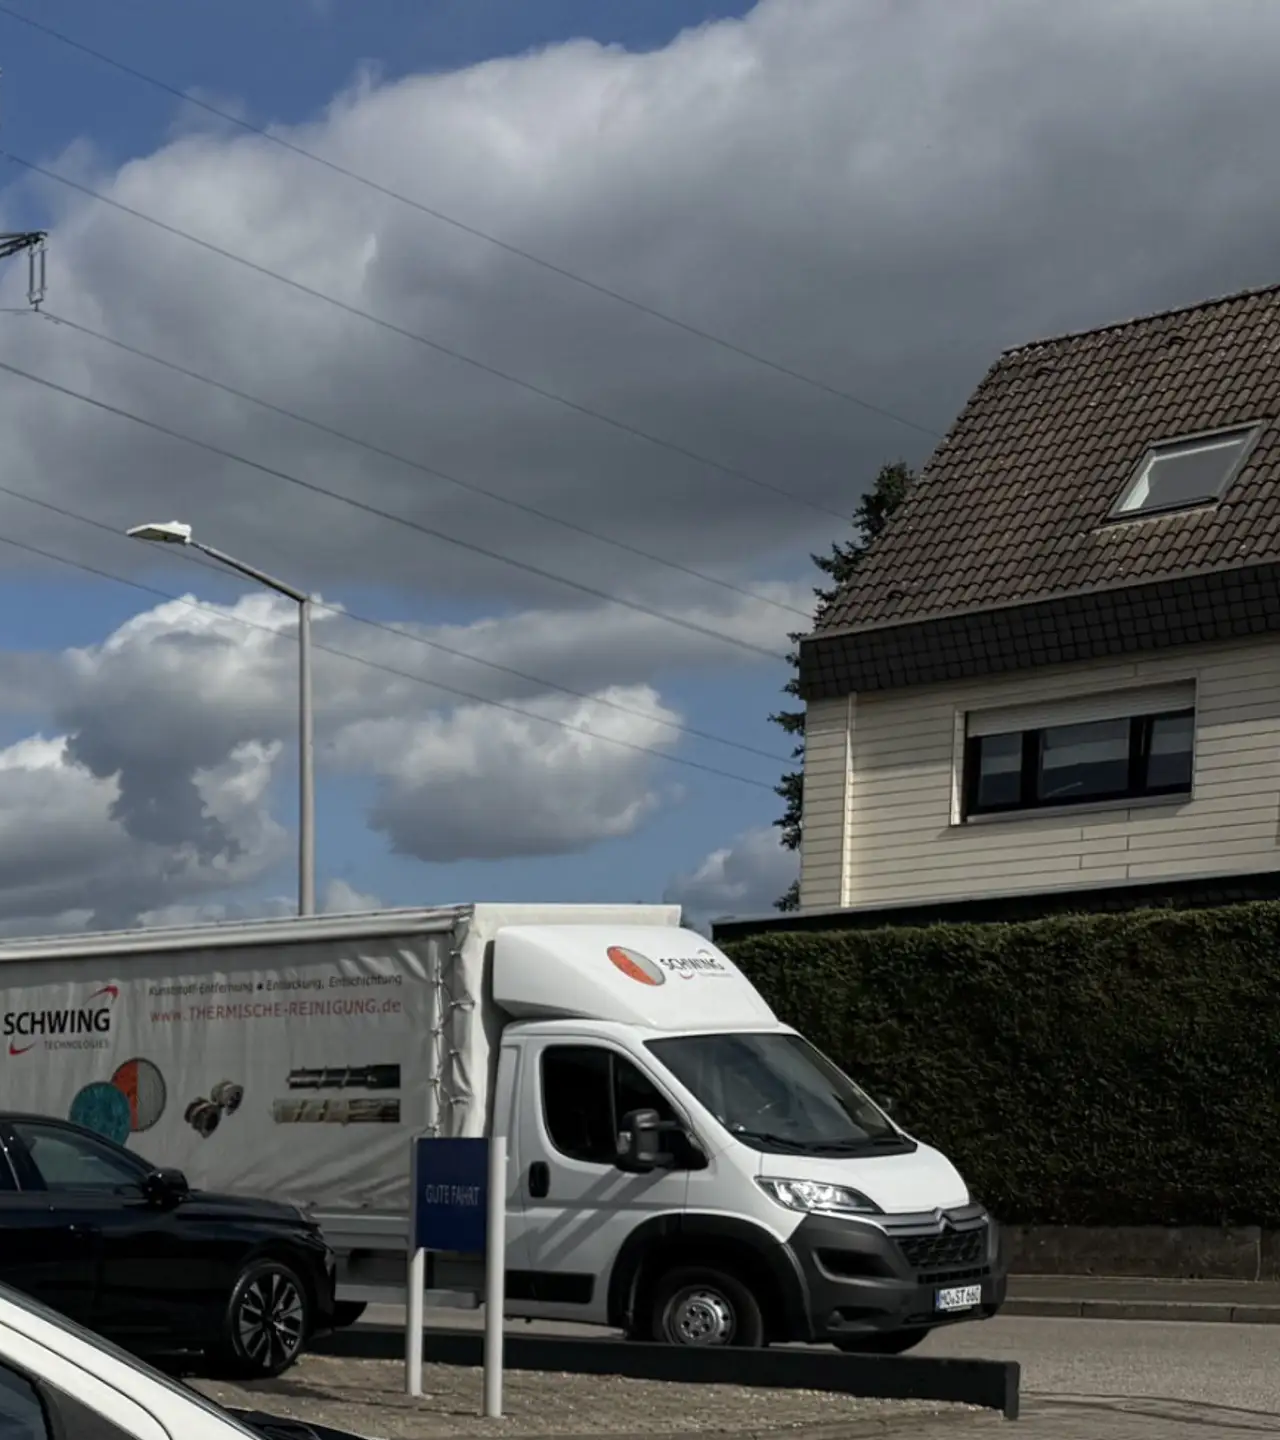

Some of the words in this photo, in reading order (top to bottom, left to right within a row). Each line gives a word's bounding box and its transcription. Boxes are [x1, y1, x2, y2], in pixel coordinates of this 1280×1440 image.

[3, 1008, 110, 1036] SCHWING
[149, 998, 402, 1023] www.THERMISCHE-REINIGUNG.de
[425, 1184, 450, 1205] GUTE
[451, 1185, 481, 1206] FAHRT
